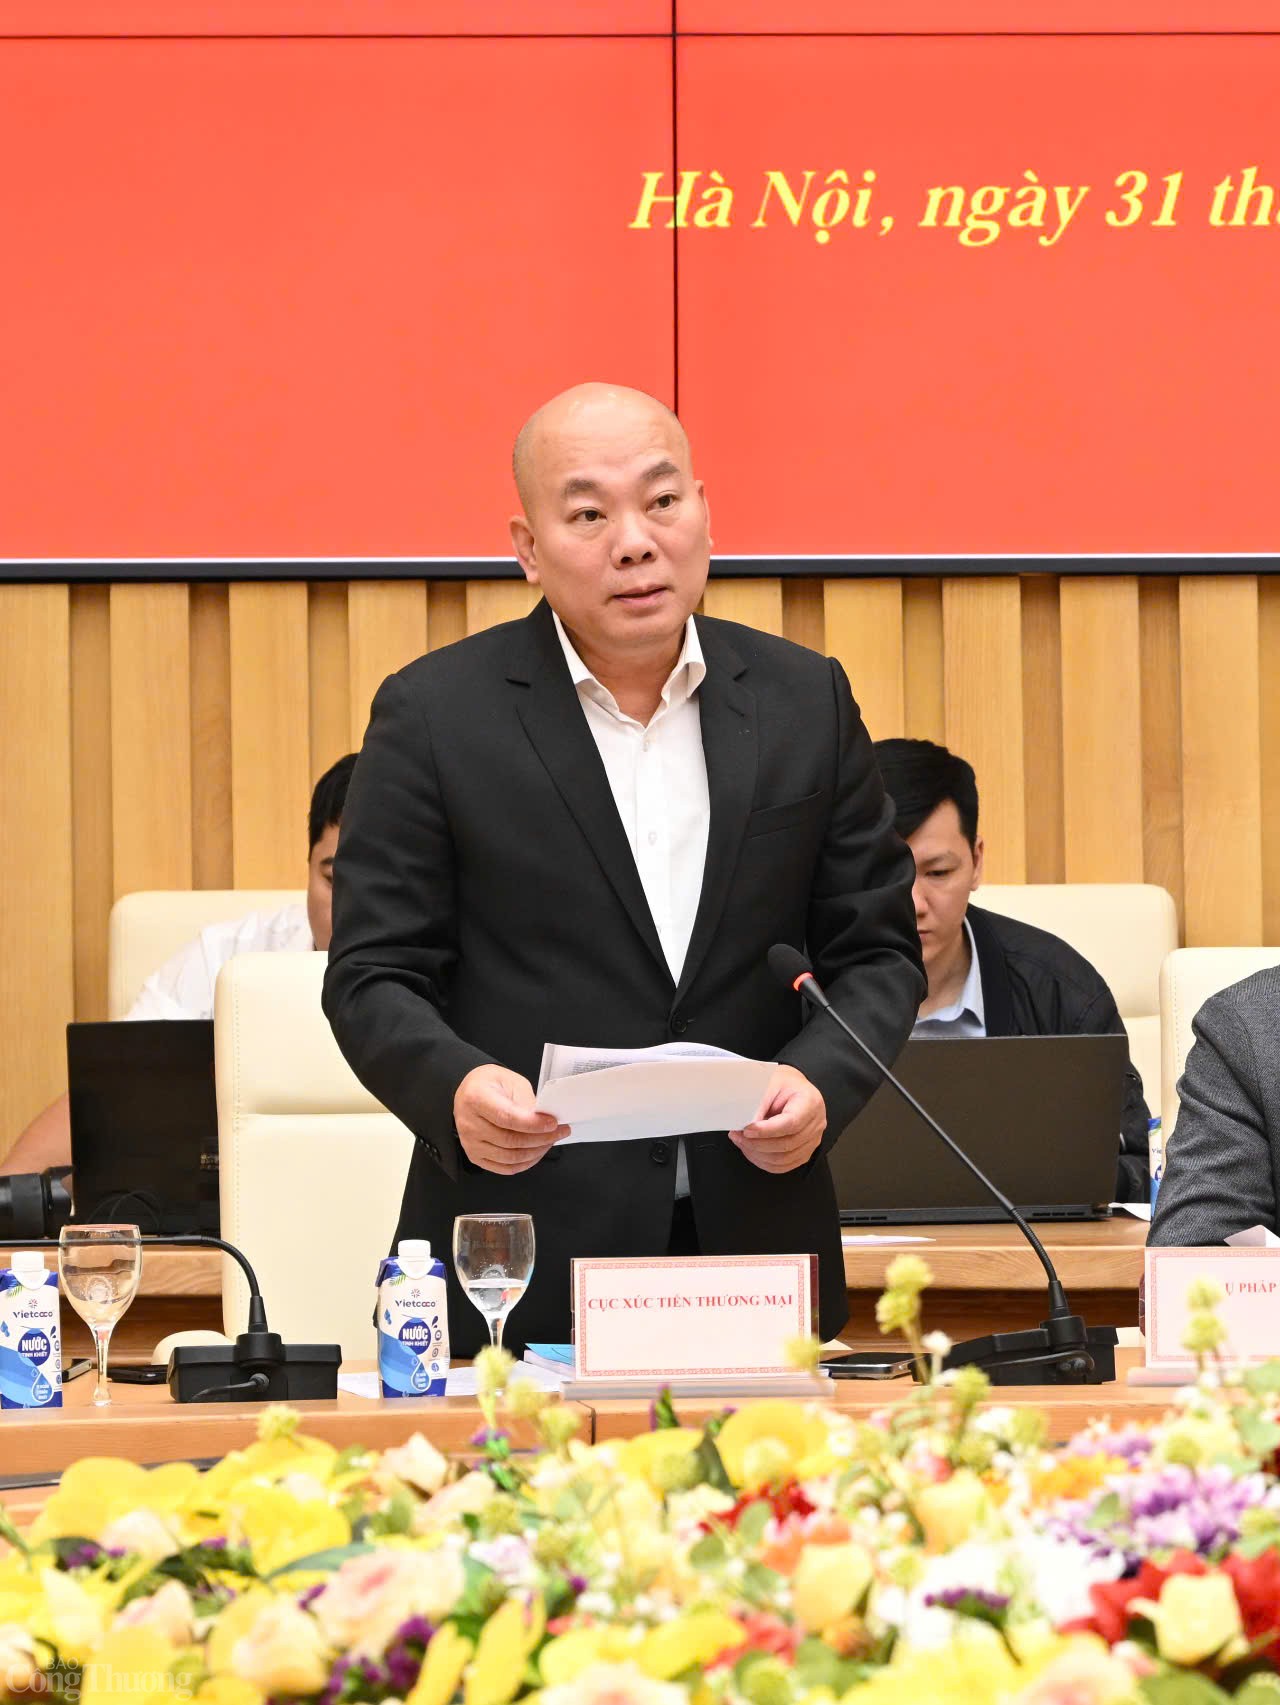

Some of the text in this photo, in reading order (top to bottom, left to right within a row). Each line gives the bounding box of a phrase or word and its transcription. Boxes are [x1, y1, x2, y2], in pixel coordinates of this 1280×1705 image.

[628, 170, 734, 229] Hà
[752, 169, 894, 245] Nội,
[918, 169, 1090, 247] ngày
[1105, 170, 1183, 227] 31
[1239, 1279, 1277, 1294] PHÁP
[395, 1299, 435, 1307] Vietcoco
[588, 1293, 794, 1312] CỤC XÚC TIẾN THƯƠNG MẠI
[402, 1325, 428, 1339] NƯỚC
[21, 1336, 47, 1351] NƯỚC
